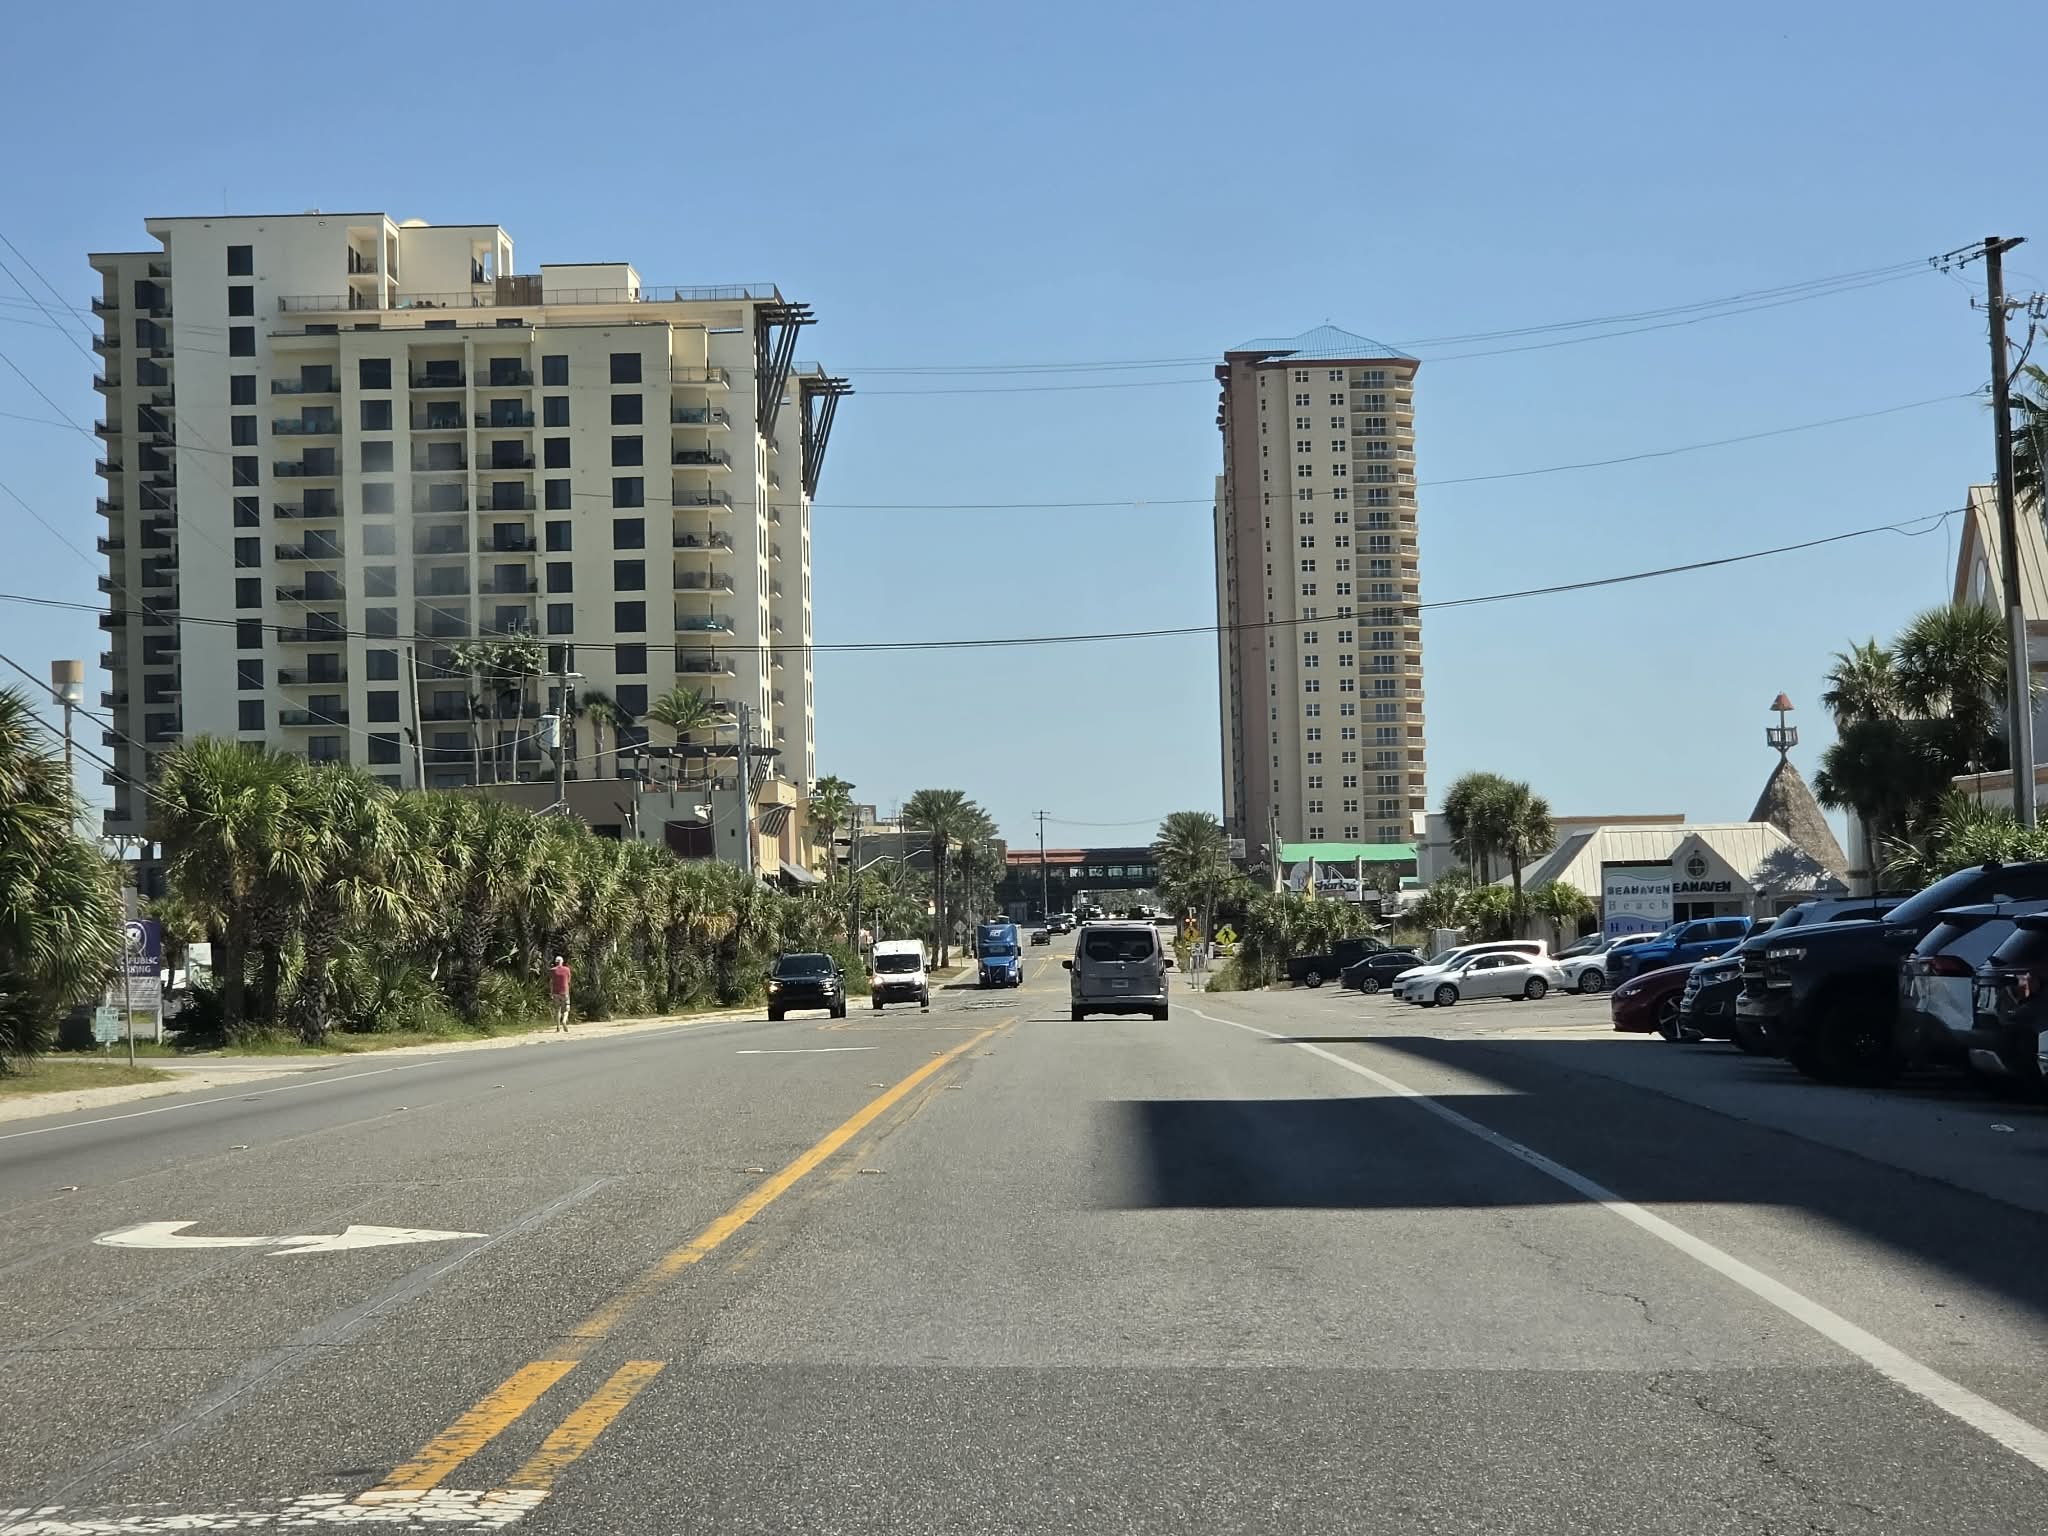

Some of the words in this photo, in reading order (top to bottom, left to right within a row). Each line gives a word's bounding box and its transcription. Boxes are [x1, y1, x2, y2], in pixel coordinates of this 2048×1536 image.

[1607, 884, 1670, 896] SEAHAVEN
[1673, 881, 1732, 893] EAHAVEN
[1608, 900, 1669, 911] Beach
[1610, 921, 1668, 932] Hotel
